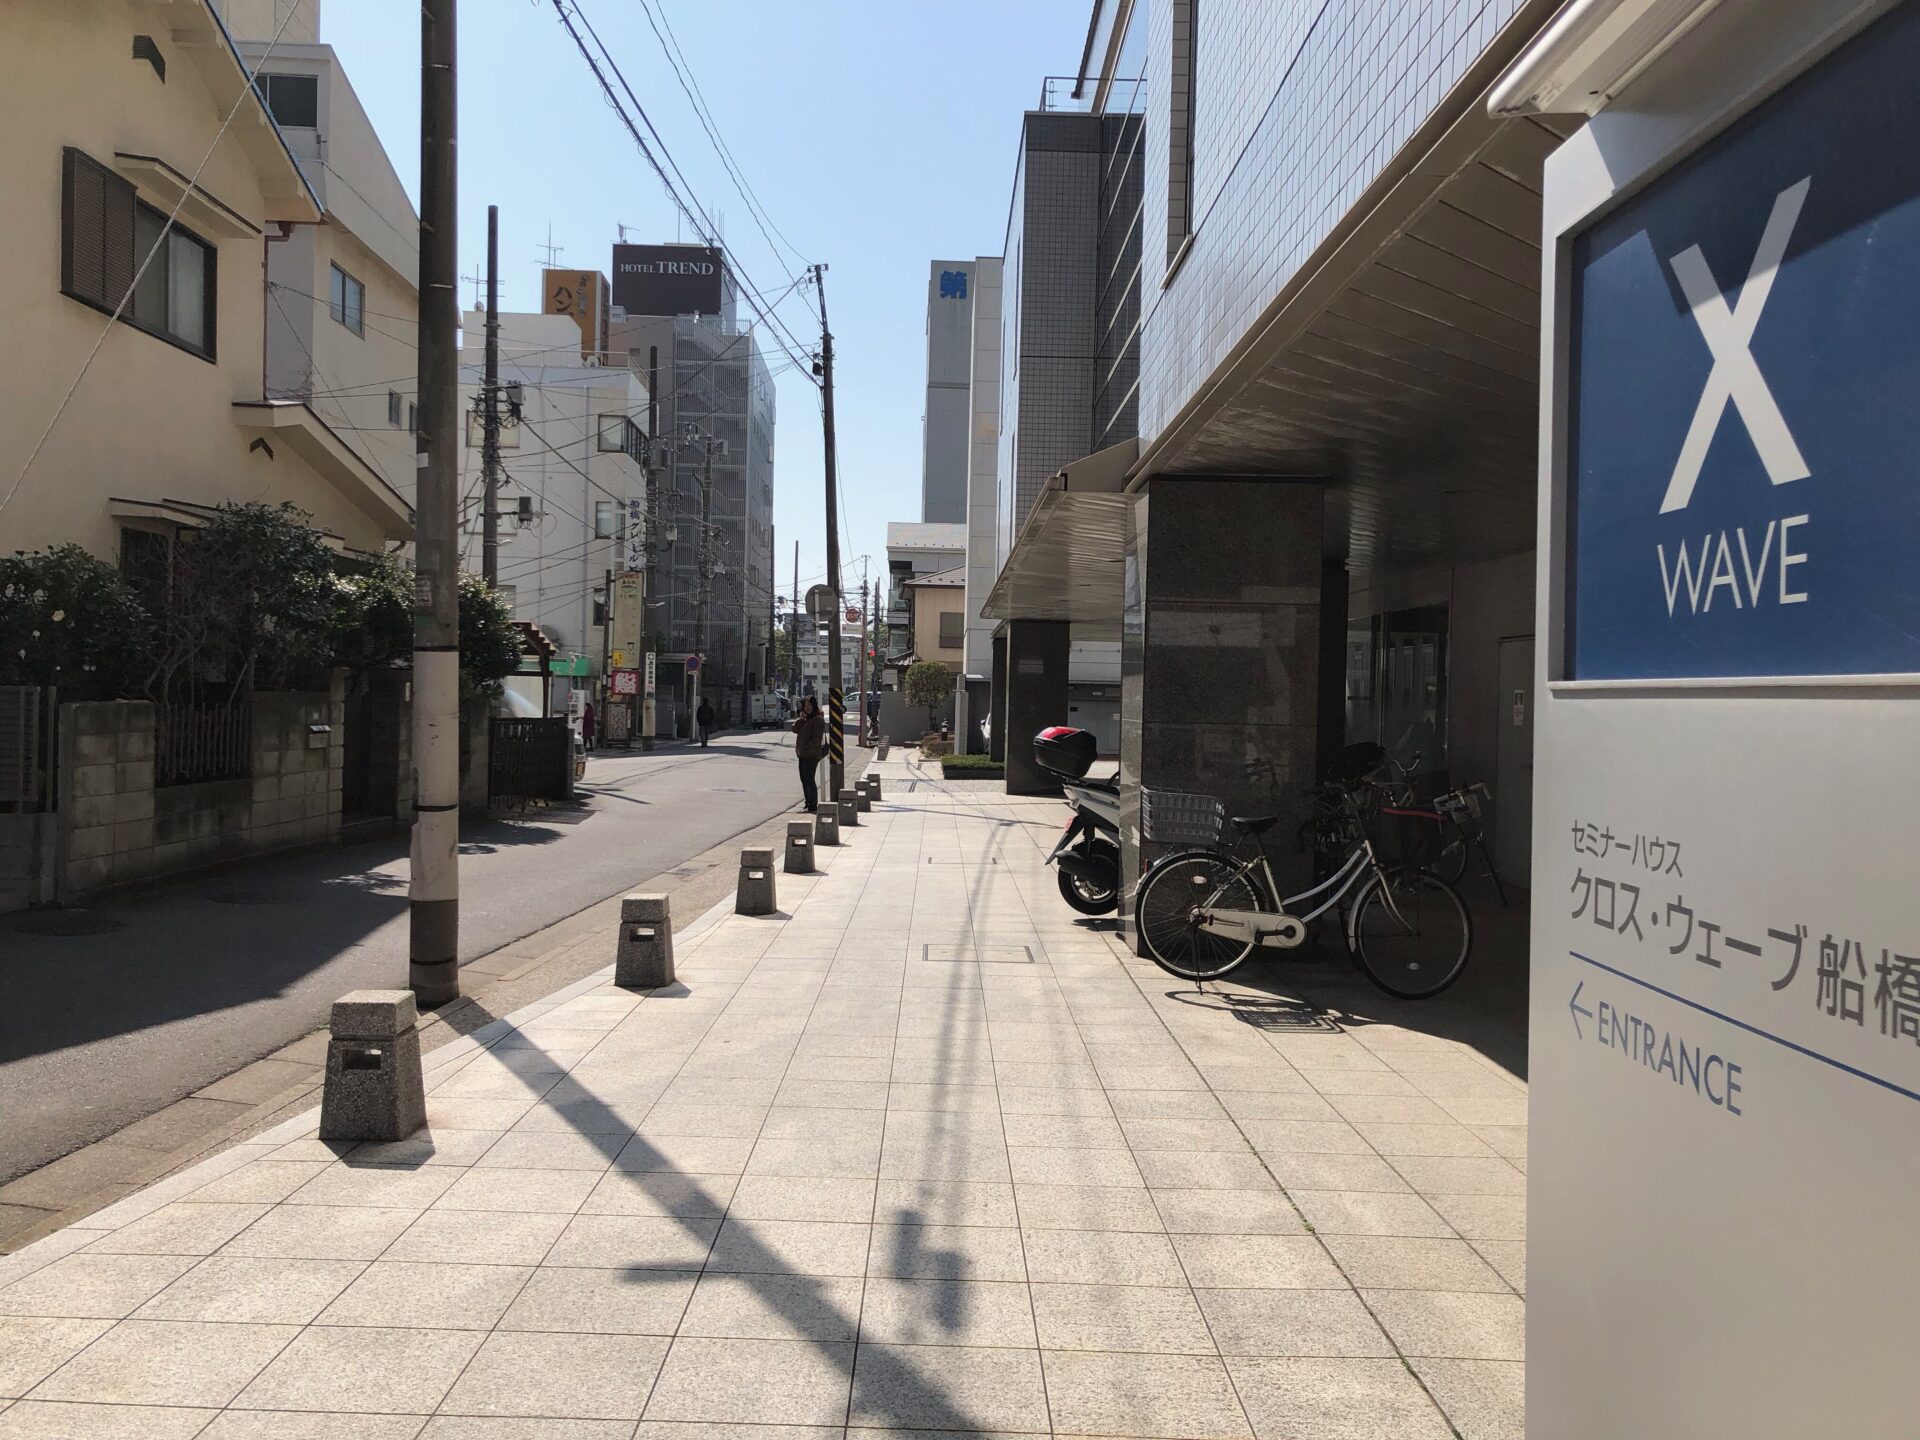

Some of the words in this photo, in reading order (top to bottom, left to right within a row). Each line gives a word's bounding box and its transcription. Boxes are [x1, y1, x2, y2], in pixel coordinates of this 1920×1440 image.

[620, 263, 656, 274] HOTEL
[656, 261, 714, 276] TREND
[1657, 514, 1809, 618] WAVE
[1571, 820, 1683, 878] セミナーハウス
[1598, 1000, 1742, 1116] ENTRANCE
